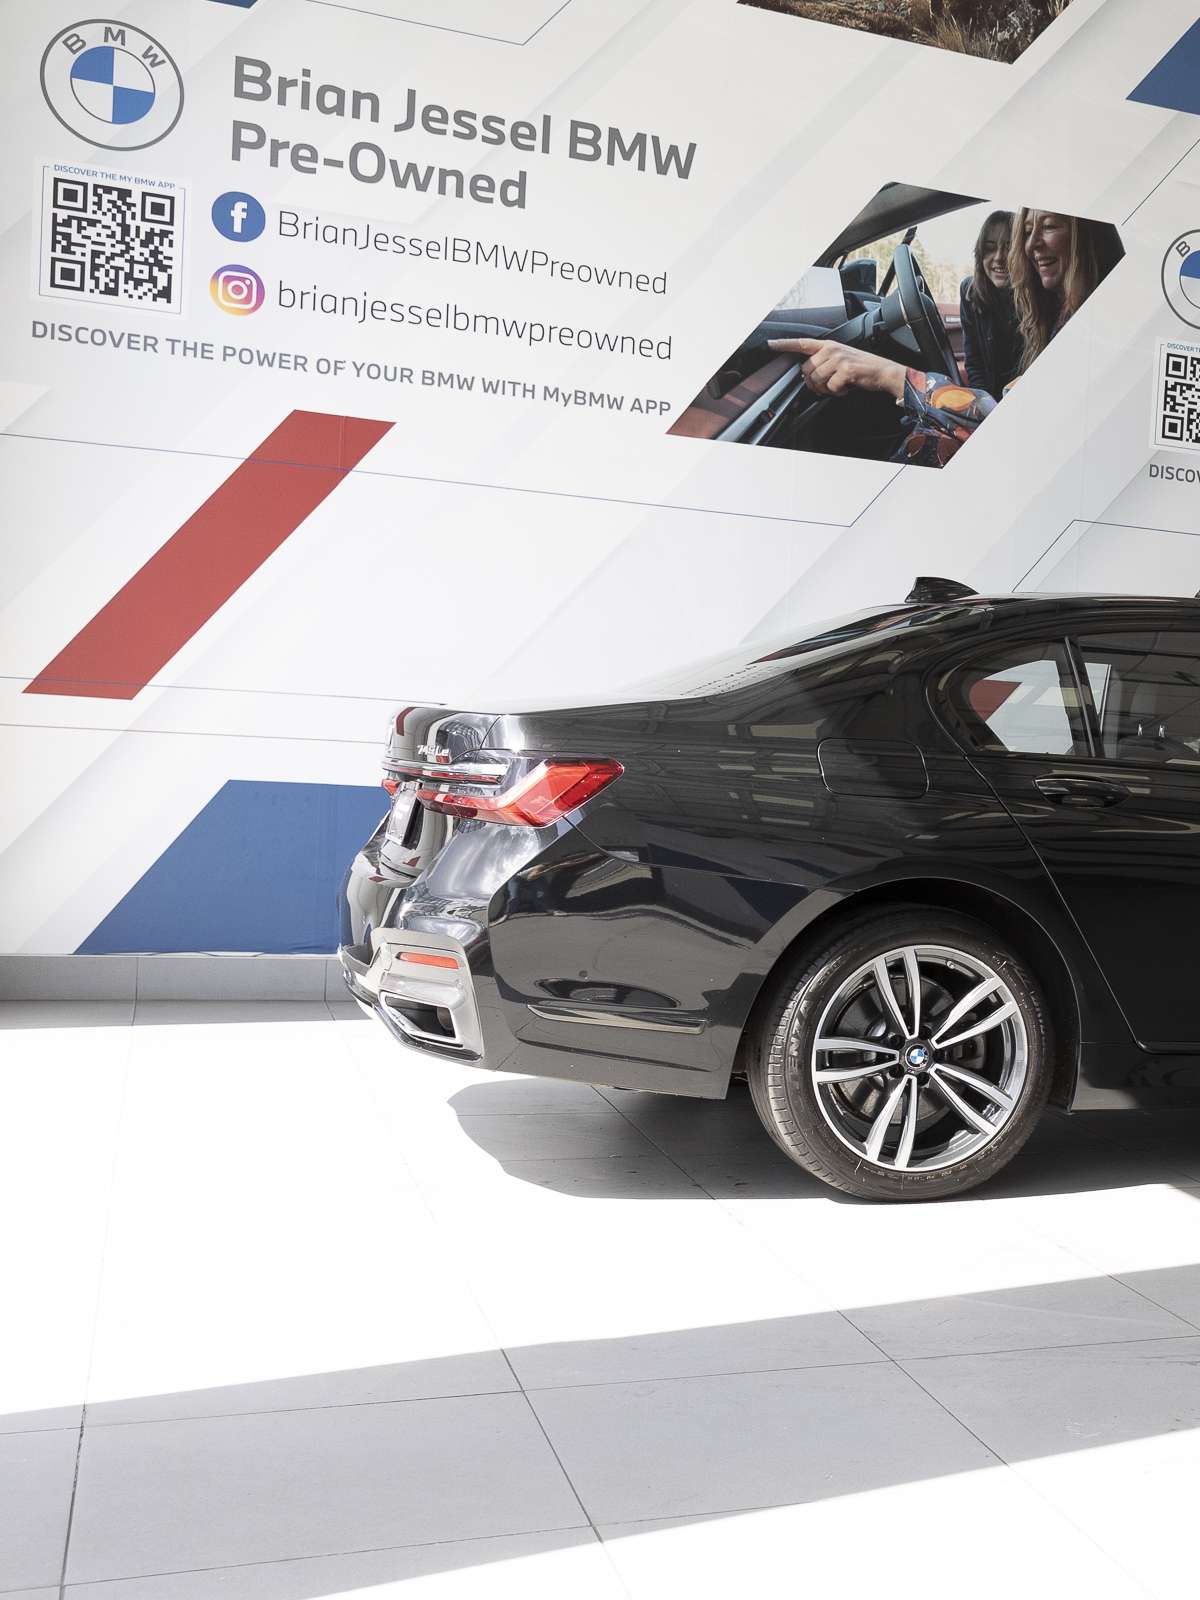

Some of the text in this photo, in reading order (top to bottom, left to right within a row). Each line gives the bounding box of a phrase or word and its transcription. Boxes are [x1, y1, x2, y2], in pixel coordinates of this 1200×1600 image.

[62, 26, 167, 71] BMW
[234, 56, 697, 179] Brian Jessel BMW
[54, 164, 176, 189] DISCOVER THE MY BMW APP
[232, 120, 527, 209] Pre-Owned
[279, 210, 666, 295] BrianJesselBMWPreowned
[279, 280, 671, 360] brianjesselbmwpreowned
[1167, 342, 1194, 352] DISCOVER
[32, 321, 671, 416] DISCOVER THE POWER OF YOUR BMW WITH MyBMW APP
